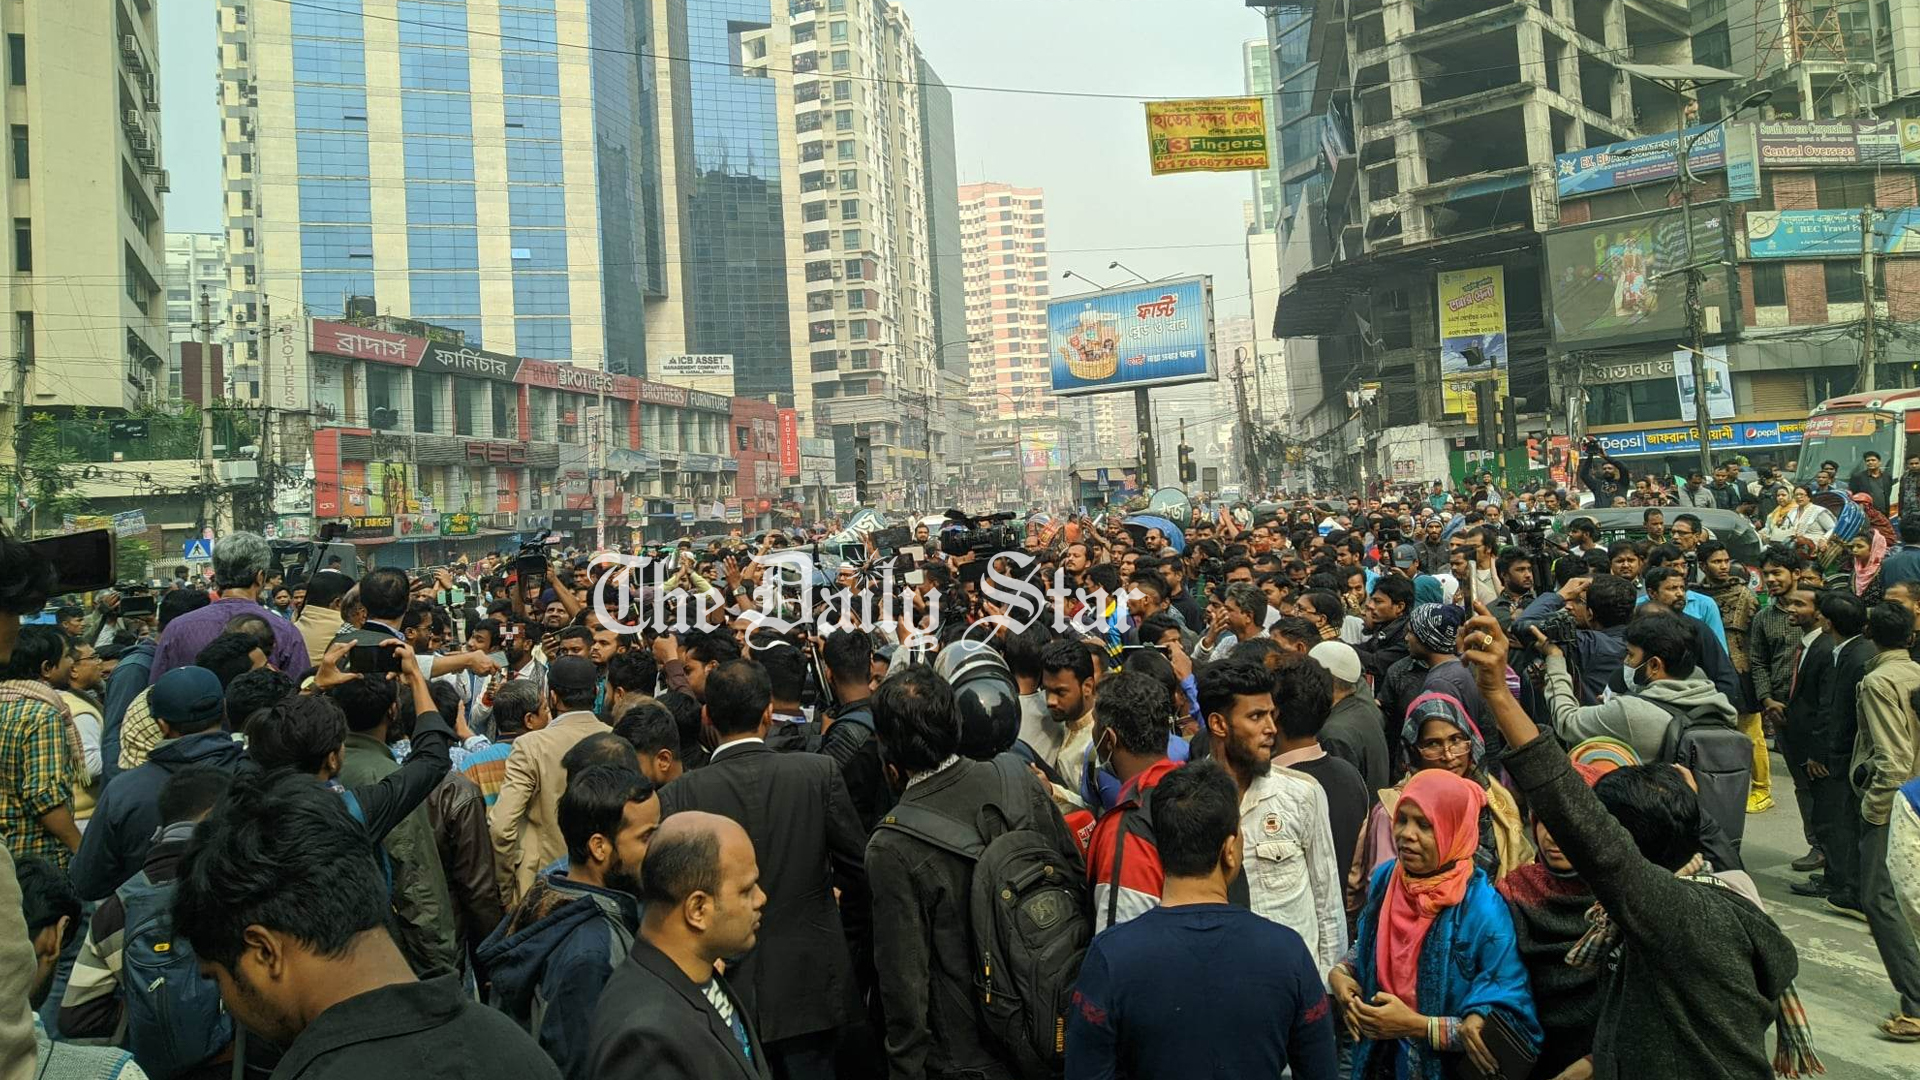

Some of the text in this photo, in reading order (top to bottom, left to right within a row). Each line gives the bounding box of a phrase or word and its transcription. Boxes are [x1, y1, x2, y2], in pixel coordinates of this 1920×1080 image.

[1152, 110, 1260, 129] হাতের সুন্দর লেখা
[1171, 138, 1263, 152] 3 Fingers
[1762, 144, 1804, 157] Central
[1804, 145, 1856, 157] Overseas
[1800, 225, 1821, 233] BEC
[1822, 225, 1851, 233] Travel
[281, 324, 297, 407] BROTHERS
[434, 347, 508, 377] ফার্নিচার
[677, 356, 725, 365] ICB ASSET
[1597, 361, 1652, 379] নাভানা
[558, 366, 614, 392] BROTHERS
[642, 382, 729, 412] BROTHERS FURNITURE
[1757, 426, 1778, 438] pepsi
[1601, 434, 1641, 451] pepsi
